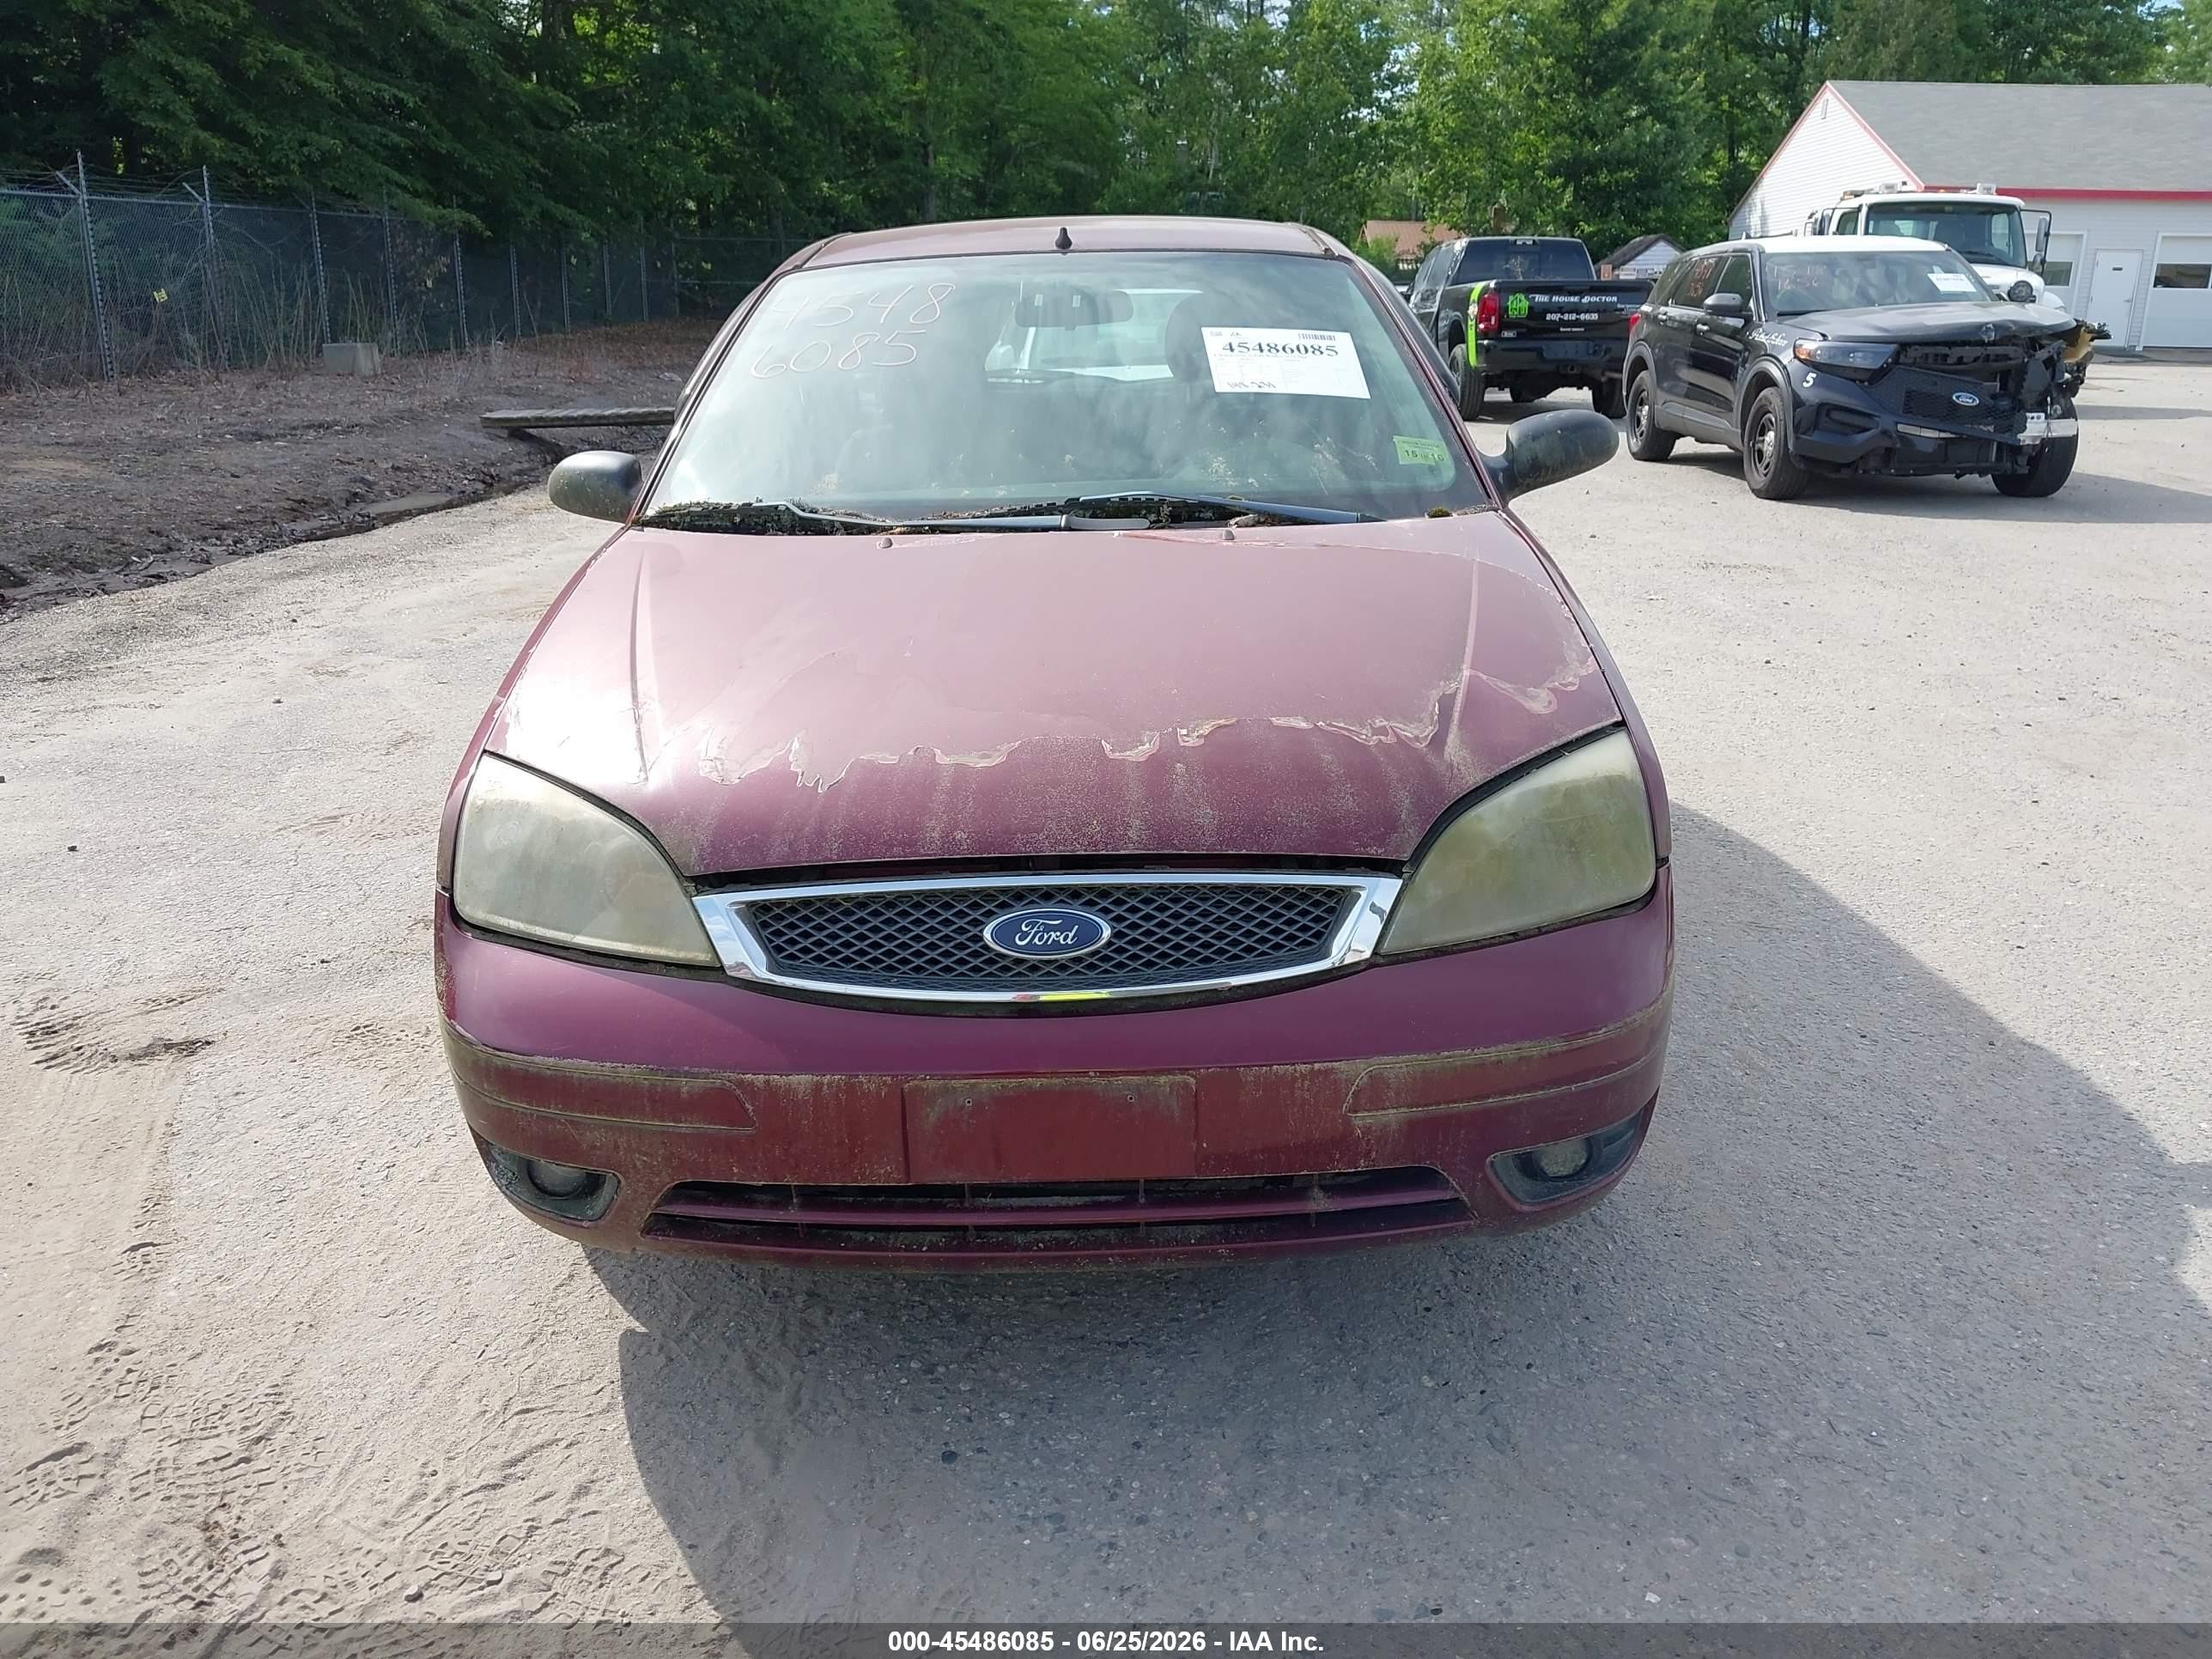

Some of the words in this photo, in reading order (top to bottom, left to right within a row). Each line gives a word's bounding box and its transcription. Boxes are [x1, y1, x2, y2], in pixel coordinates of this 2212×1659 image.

[772, 283, 956, 330] 4548
[750, 330, 927, 379] 6085
[1223, 342, 1339, 357] 45486085
[1802, 372, 1817, 387] 5
[1015, 919, 1079, 945] Ford
